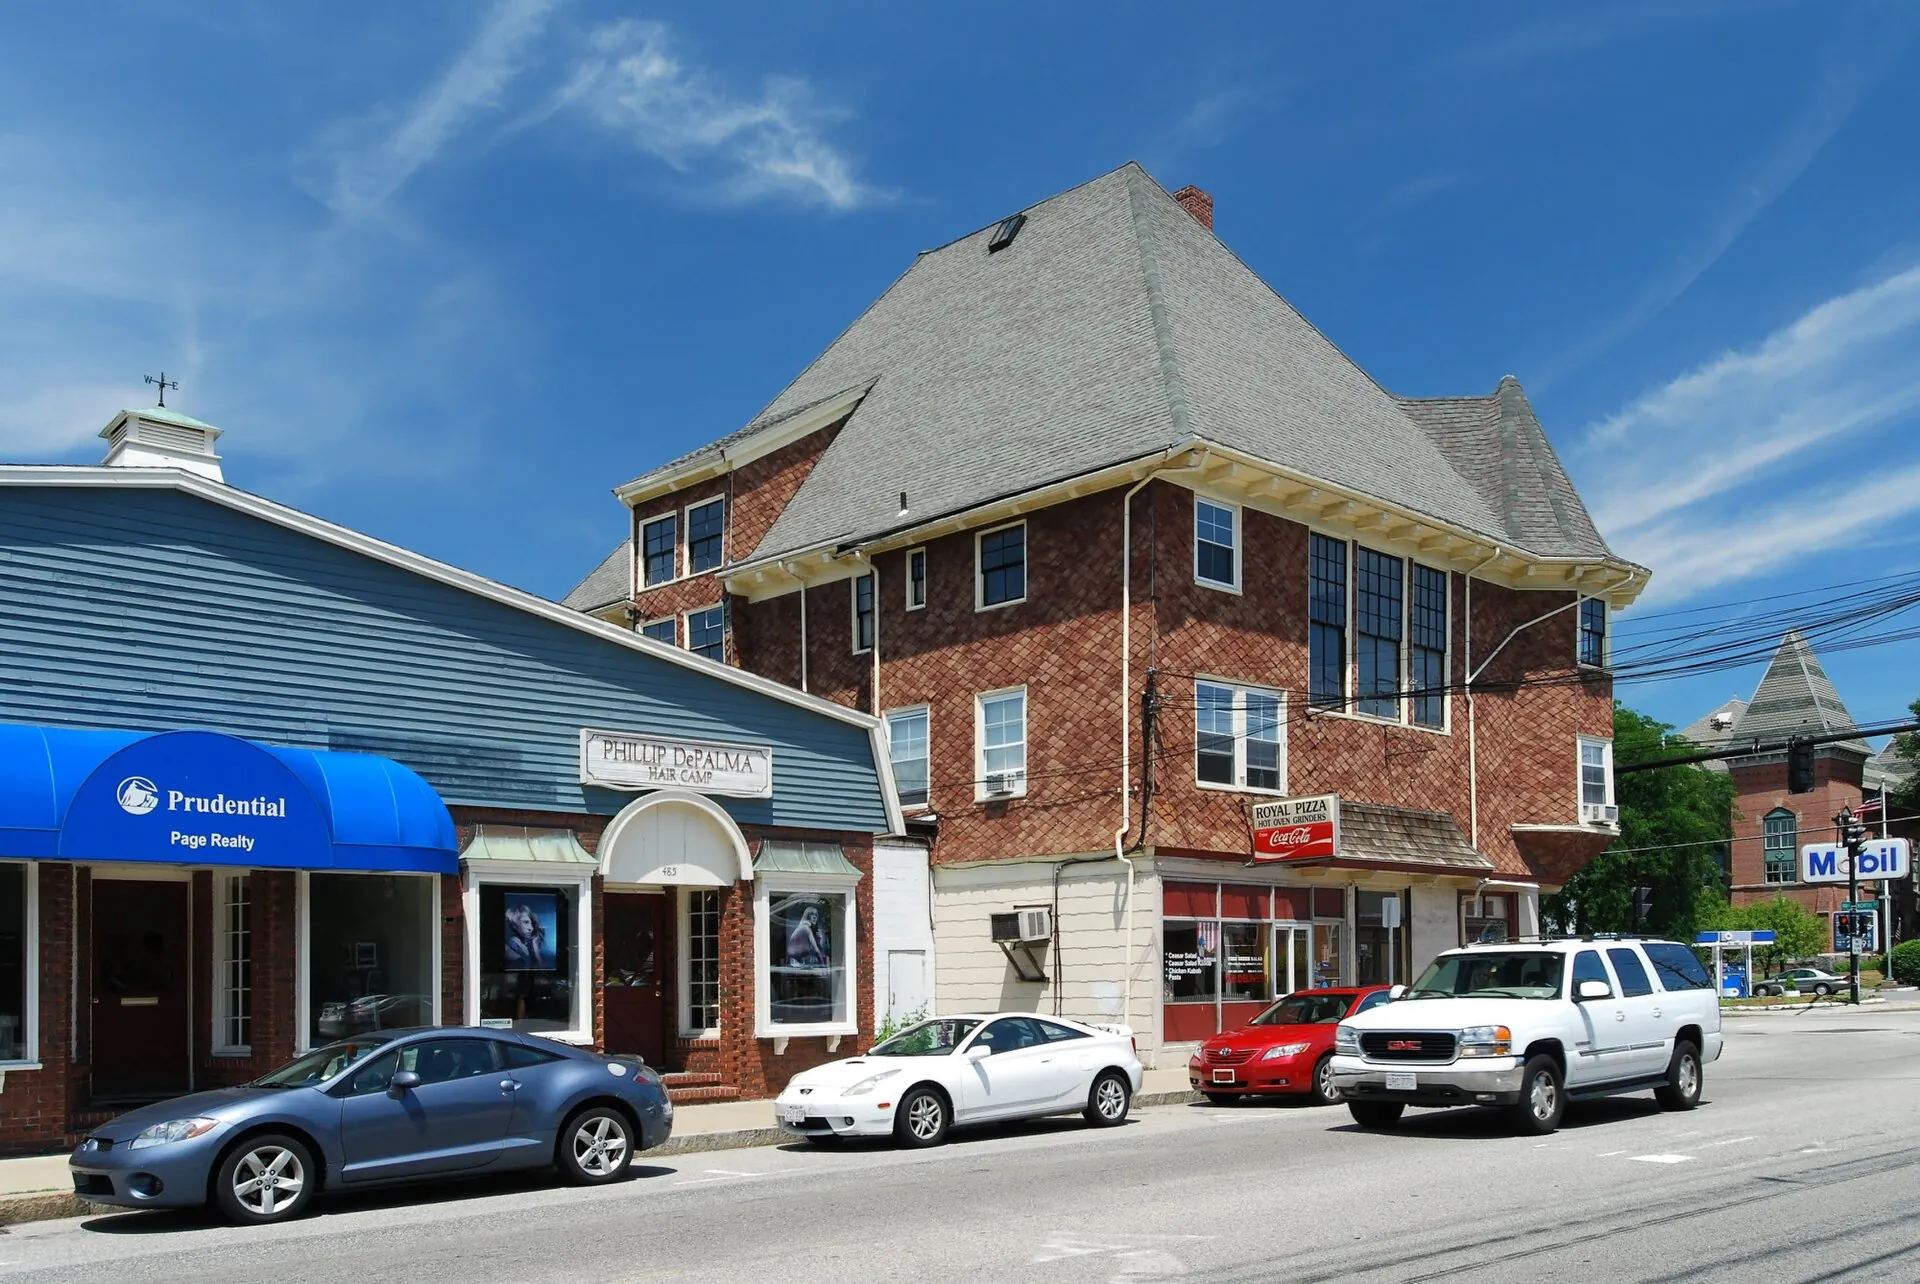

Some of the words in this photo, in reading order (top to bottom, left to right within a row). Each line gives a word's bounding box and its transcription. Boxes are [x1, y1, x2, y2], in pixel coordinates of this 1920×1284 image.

[603, 739, 667, 765] PHILLIP
[674, 747, 753, 773] DePALMA
[649, 766, 676, 781] HAIR
[680, 770, 713, 785] CAMP
[168, 790, 286, 817] Prudential
[1256, 804, 1291, 819] ROYAL
[1295, 799, 1327, 815] PIZZA
[1258, 819, 1271, 828] HOT
[1273, 817, 1291, 826] OVEN
[1292, 813, 1327, 825] GRINDERS
[171, 831, 207, 849] Page
[211, 832, 255, 852] Realty
[1270, 826, 1312, 846] Coca-Cola
[1809, 846, 1898, 877] Mobil
[1387, 1041, 1422, 1050] GMC
